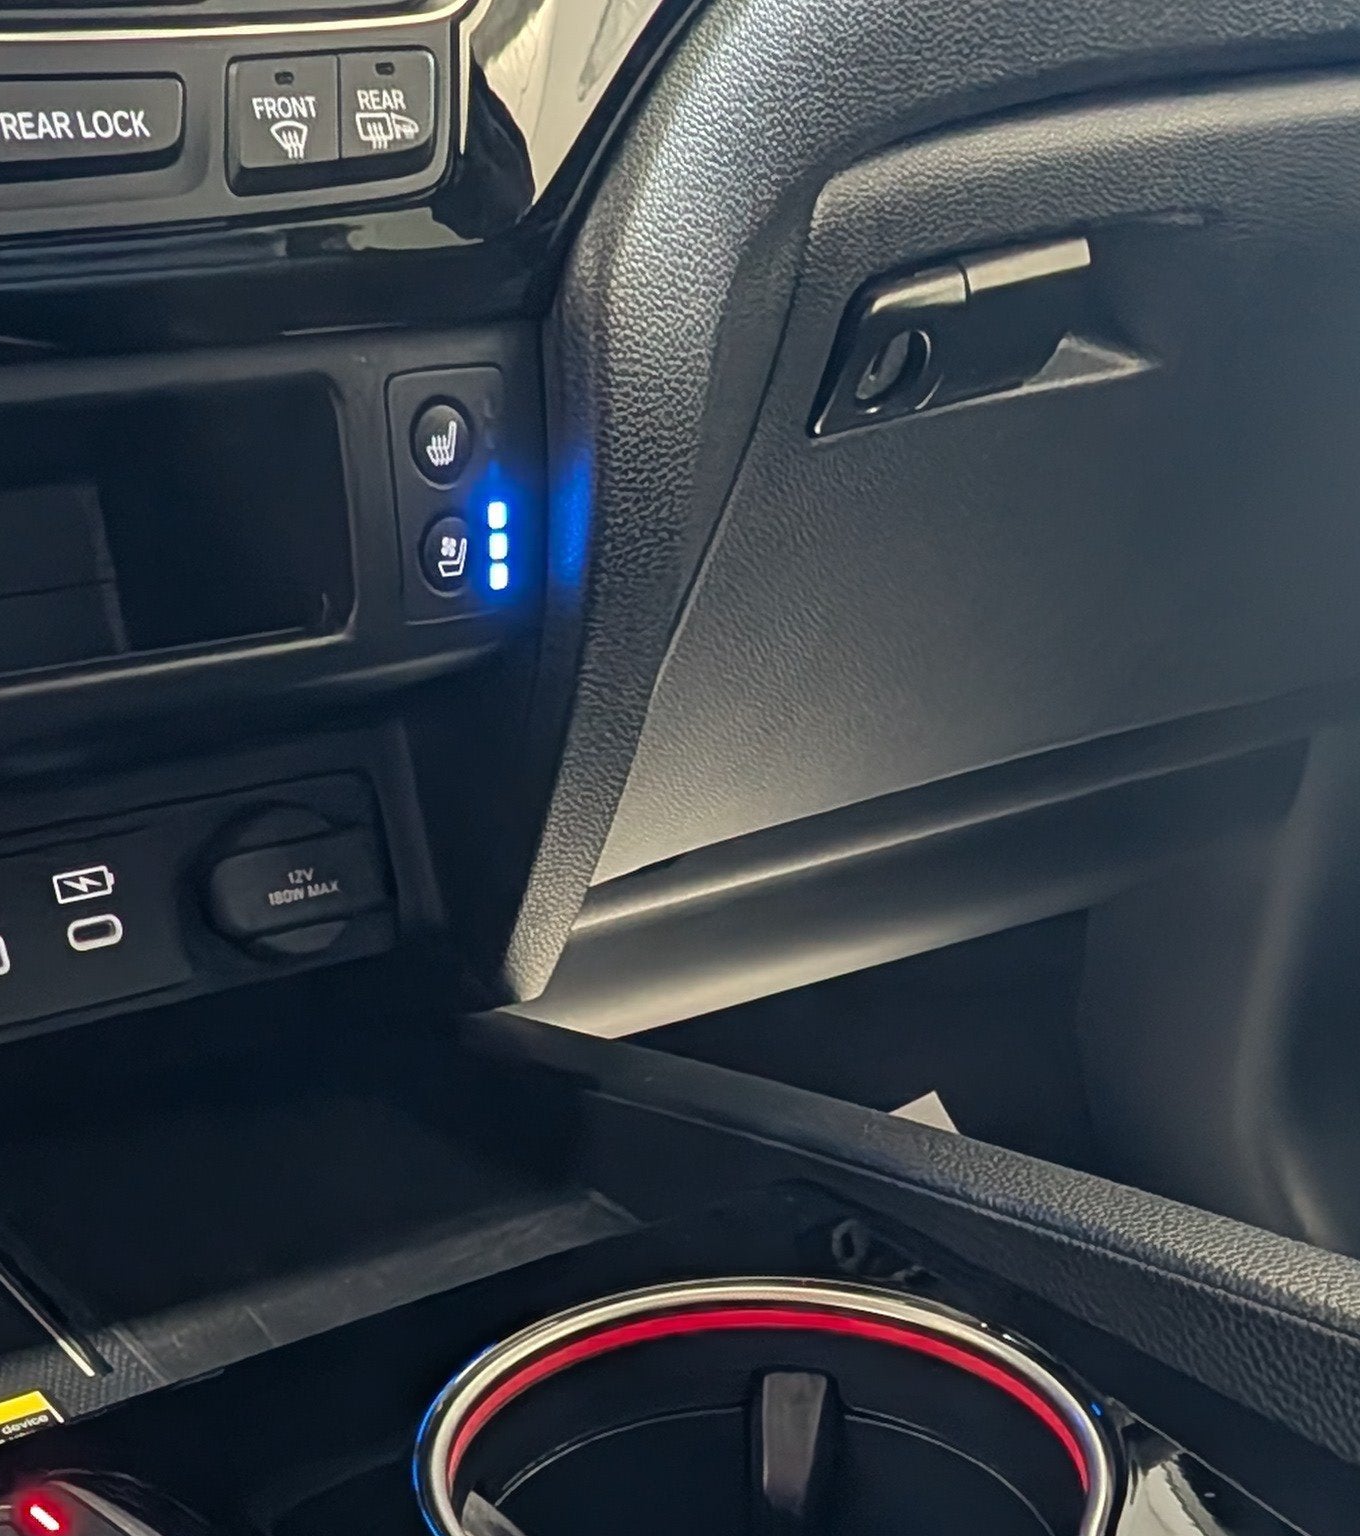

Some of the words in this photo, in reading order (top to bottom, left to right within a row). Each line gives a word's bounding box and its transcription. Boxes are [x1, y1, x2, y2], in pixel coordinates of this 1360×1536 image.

[251, 95, 318, 121] FRONT
[355, 87, 408, 111] REAR
[80, 107, 152, 139] LOCK
[288, 868, 314, 884] 12V
[307, 881, 340, 897] MAX
[2, 1414, 49, 1435] device
